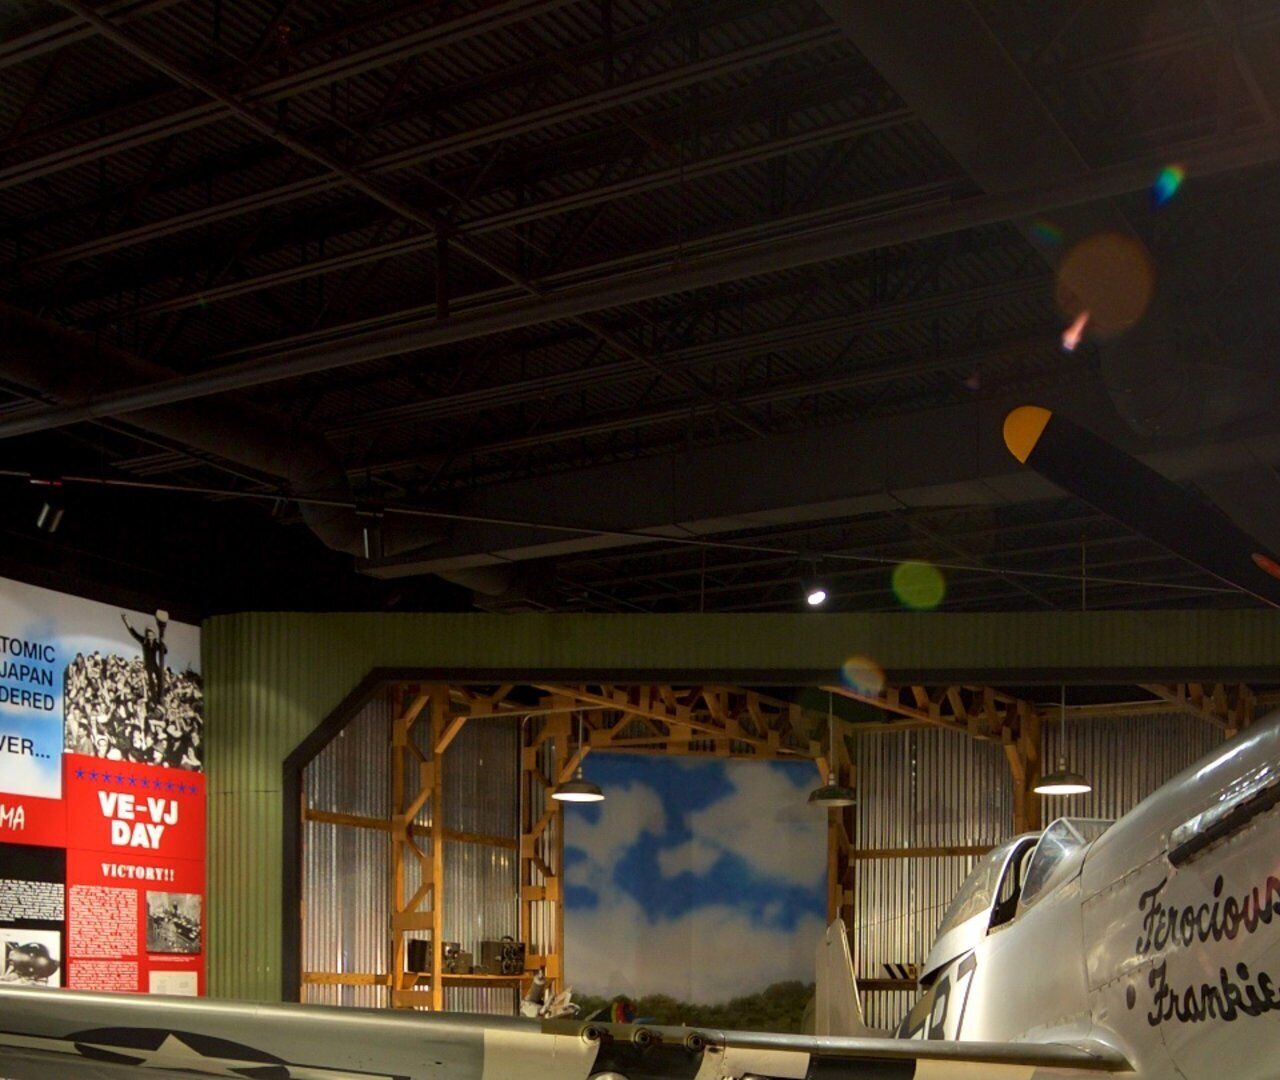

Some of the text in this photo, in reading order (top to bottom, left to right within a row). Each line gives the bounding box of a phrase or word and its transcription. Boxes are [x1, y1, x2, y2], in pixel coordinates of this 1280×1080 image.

[98, 790, 178, 825] VE-VJ
[111, 819, 164, 849] DAY
[101, 863, 175, 882] VICTORY!!
